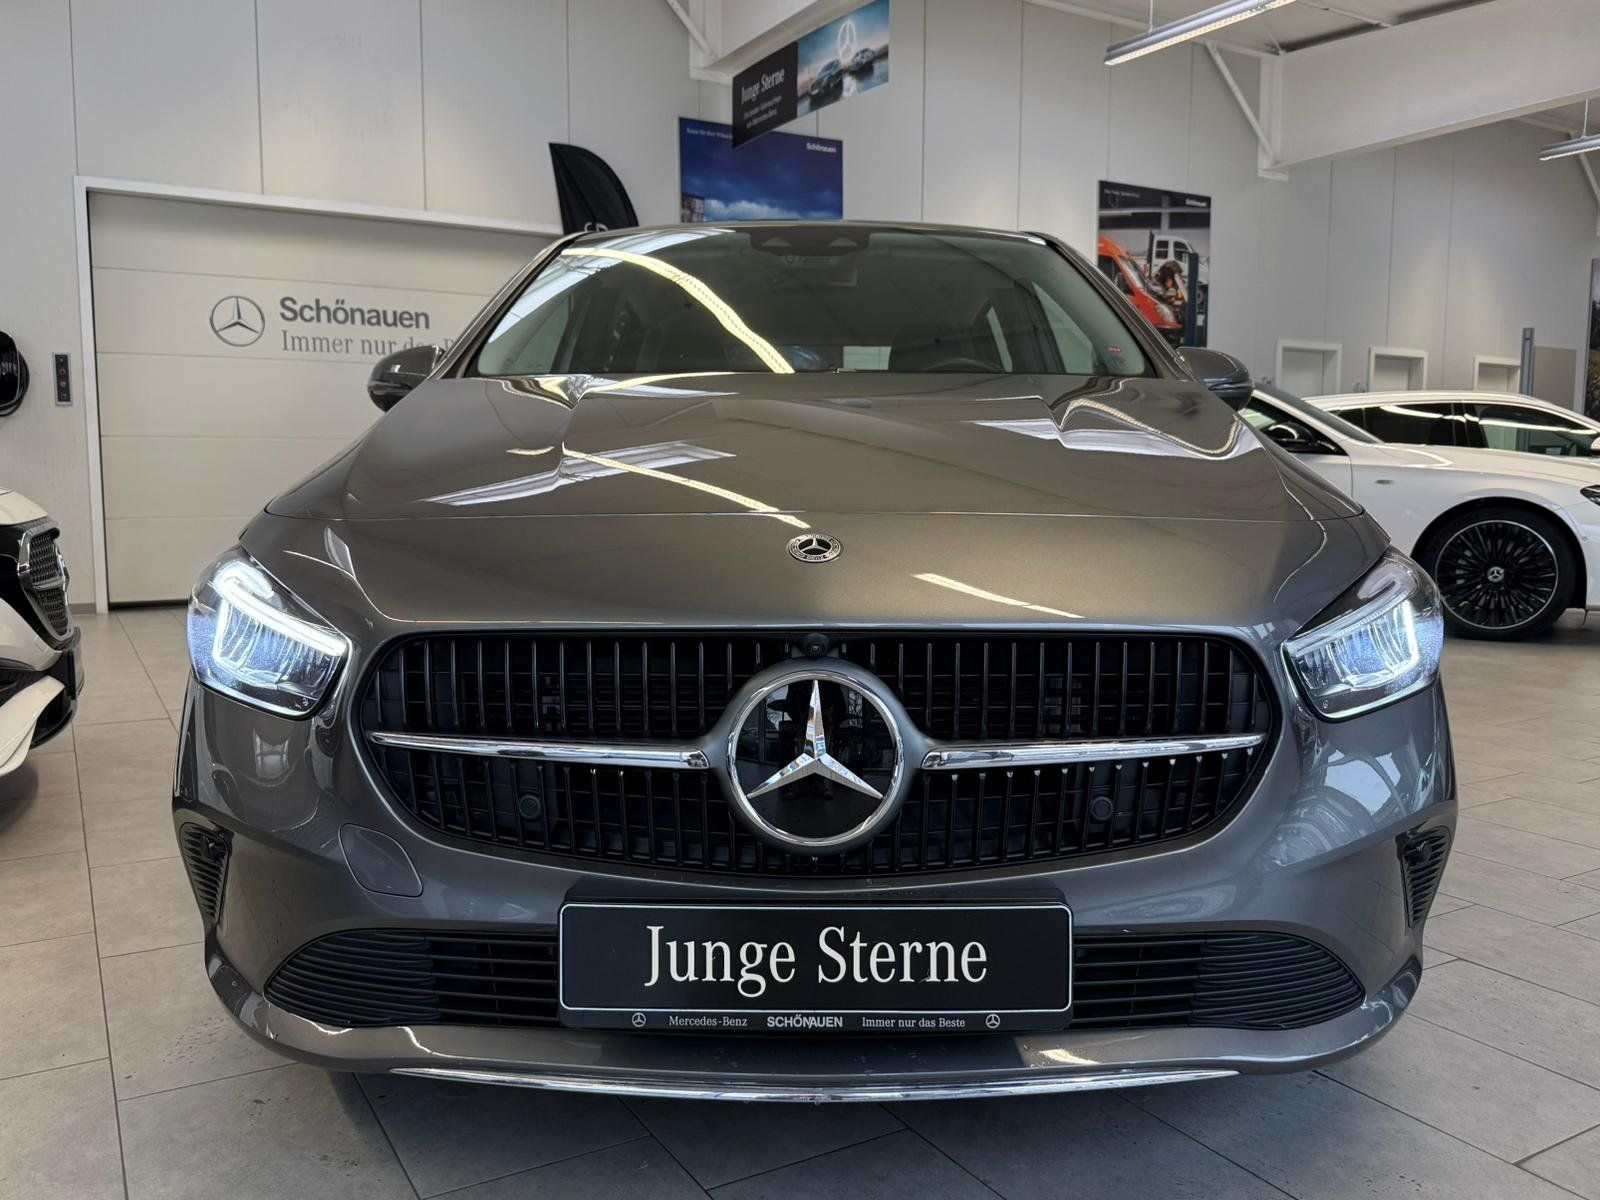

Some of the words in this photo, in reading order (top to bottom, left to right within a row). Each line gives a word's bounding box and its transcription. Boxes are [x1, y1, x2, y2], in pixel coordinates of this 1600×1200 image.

[741, 81, 760, 105] Junge
[761, 68, 785, 91] Sterne
[279, 296, 430, 329] Schönauen
[282, 330, 354, 354] Immer
[360, 337, 397, 355] nur
[644, 925, 796, 998] Junge
[818, 926, 987, 983] Sterne
[668, 1015, 748, 1027] Mercedes-Benz
[766, 1013, 843, 1028] SCHÖNAUEN
[862, 1016, 896, 1028] Immer
[898, 1019, 916, 1028] nur
[918, 1017, 936, 1028] das
[938, 1017, 966, 1028] Beste
